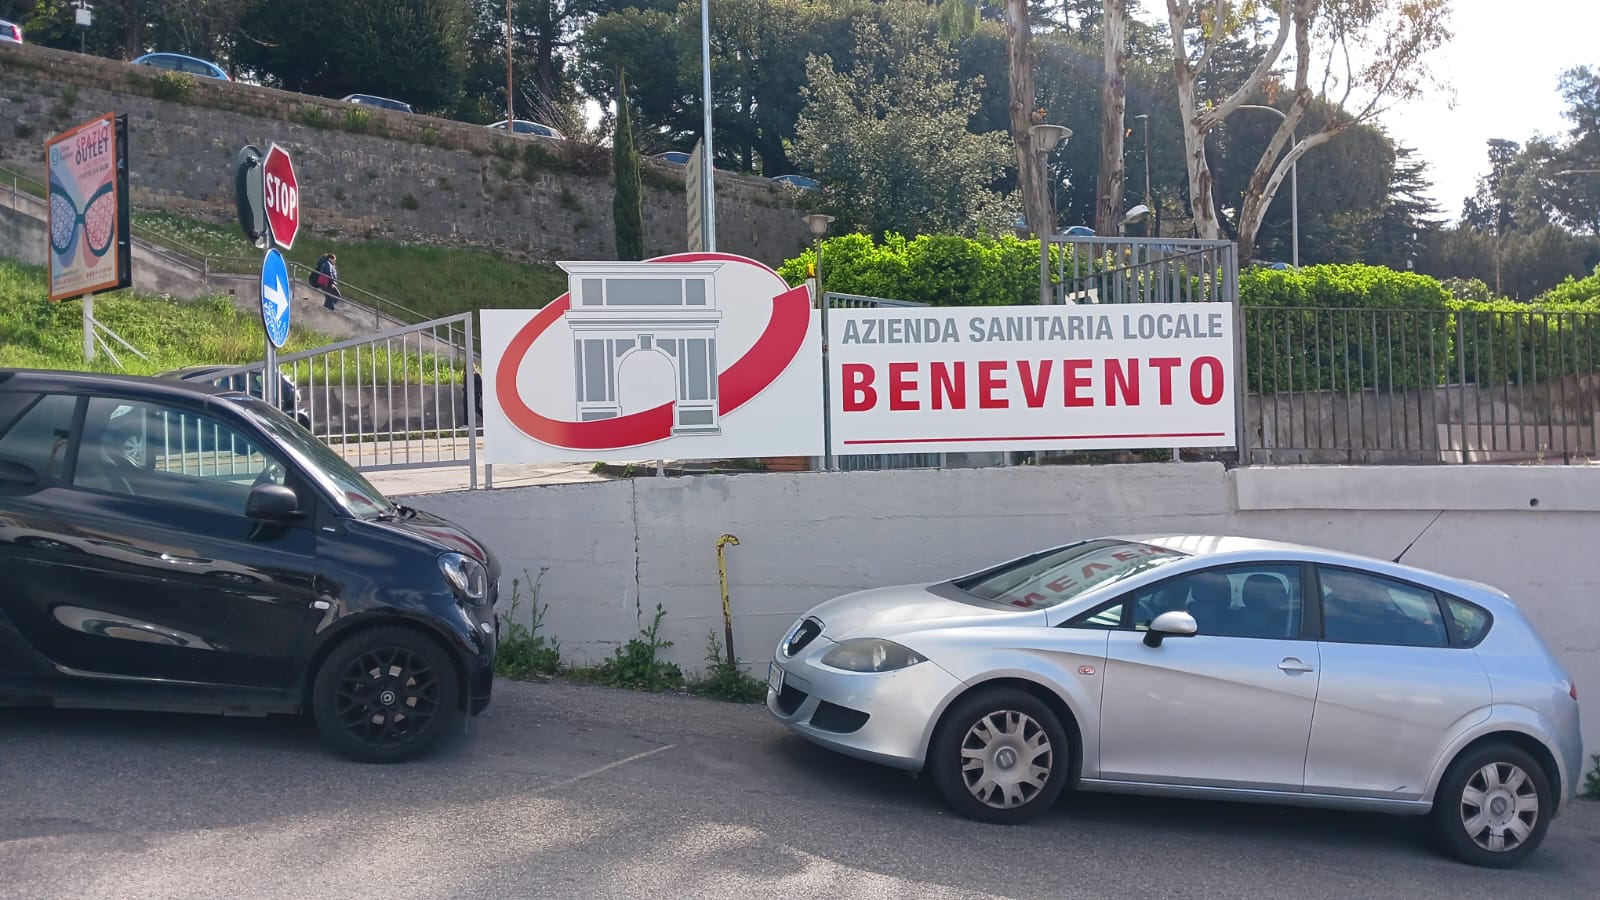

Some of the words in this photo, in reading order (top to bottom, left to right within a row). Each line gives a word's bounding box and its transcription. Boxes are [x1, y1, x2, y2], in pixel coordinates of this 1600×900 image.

[75, 139, 108, 165] OUTLET
[76, 126, 108, 150] SPAZIO
[266, 172, 296, 220] STOP
[842, 317, 961, 345] AZIENDA
[968, 315, 1114, 343] SANITARIA
[1123, 313, 1223, 339] LOCALE
[841, 355, 1225, 412] BENEVENTO
